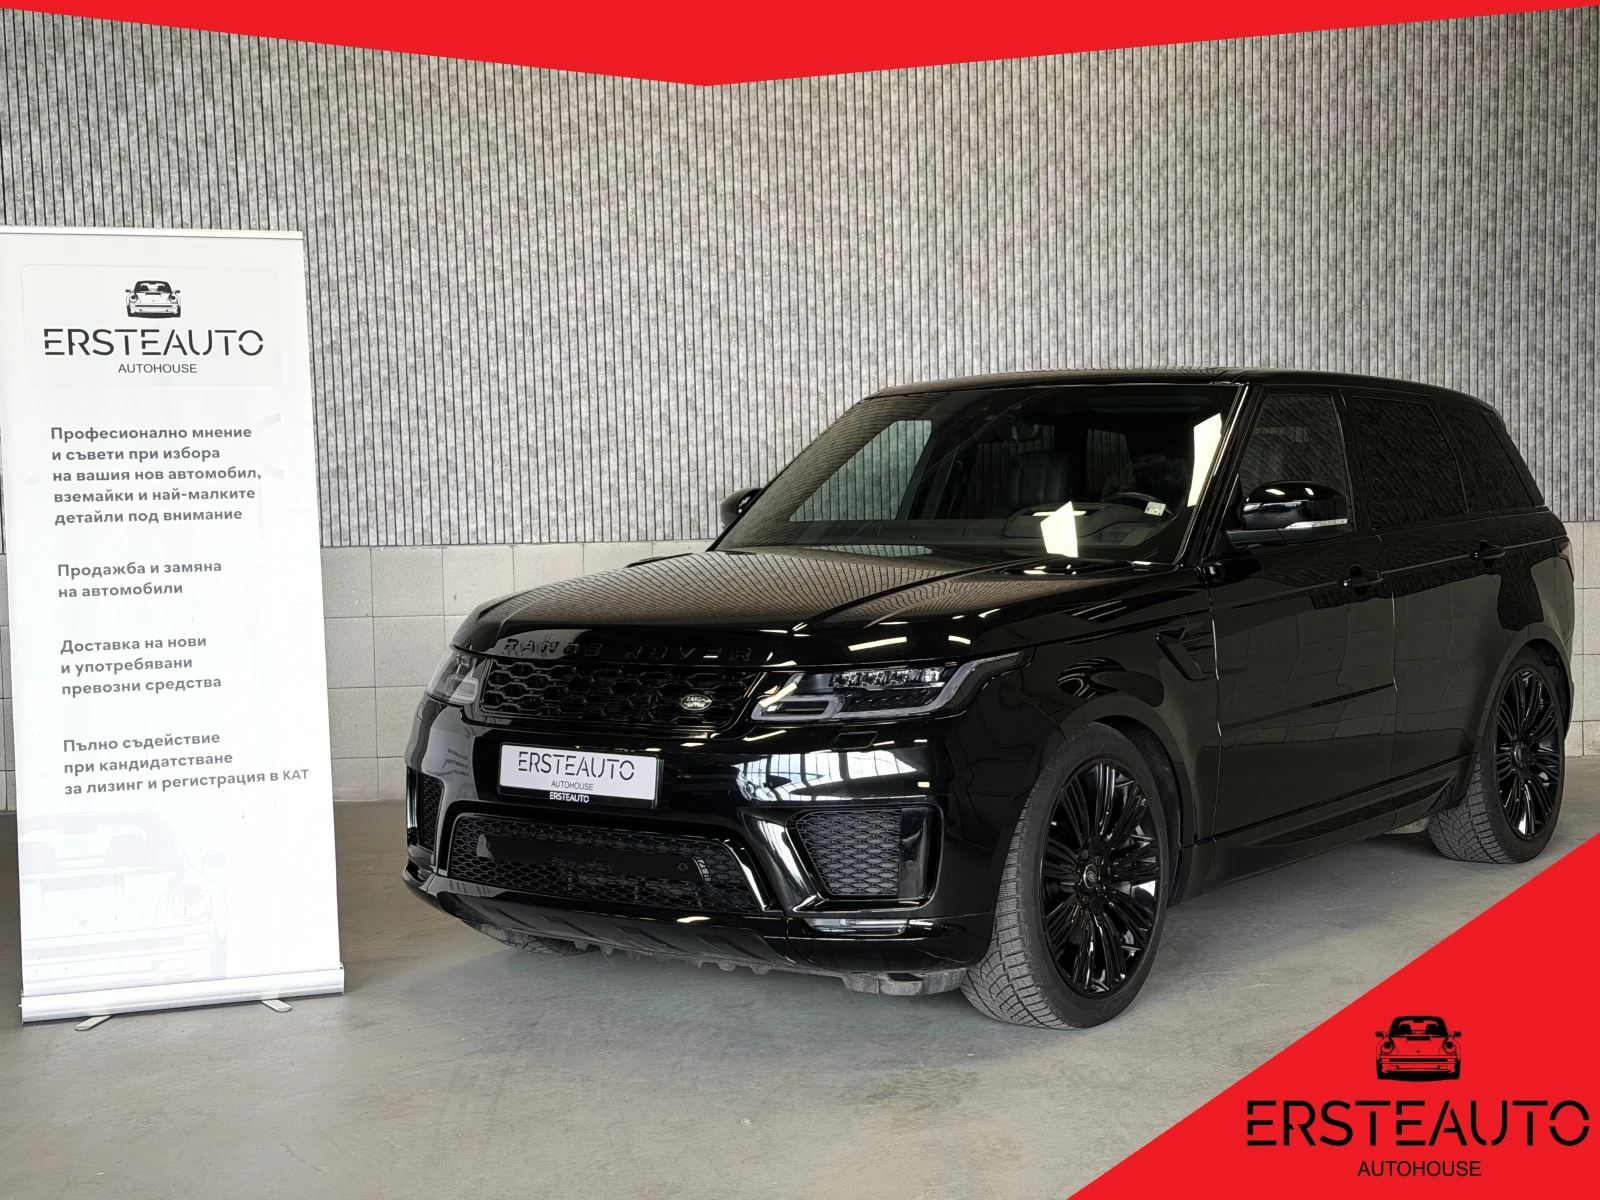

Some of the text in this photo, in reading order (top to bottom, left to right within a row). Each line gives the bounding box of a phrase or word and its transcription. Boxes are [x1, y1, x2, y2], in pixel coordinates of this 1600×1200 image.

[43, 328, 264, 357] ERSTEAUTO
[117, 363, 198, 374] AUTOHOUSE
[50, 426, 252, 444] Професионално мнение
[51, 446, 220, 463] и съвети при избора
[52, 465, 262, 482] на вашия нов автомобил,
[54, 486, 256, 503] вземайки и най-малките
[54, 508, 243, 526] детайли под внимание
[57, 561, 222, 581] Продажба и замяна
[58, 582, 183, 598] на автомобили
[60, 636, 207, 655] Доставка на нови
[60, 657, 193, 677] и употребявани
[61, 676, 222, 699] превозни средства
[63, 733, 221, 753] Пълно съдействие
[64, 753, 233, 777] при кандидатстване
[518, 751, 635, 781] ERSTEAUTO
[64, 768, 310, 796] за лизинг и регистрация в КАТ
[551, 780, 594, 791] AUTOHOUSE
[549, 792, 590, 803] ERSTEAUTO
